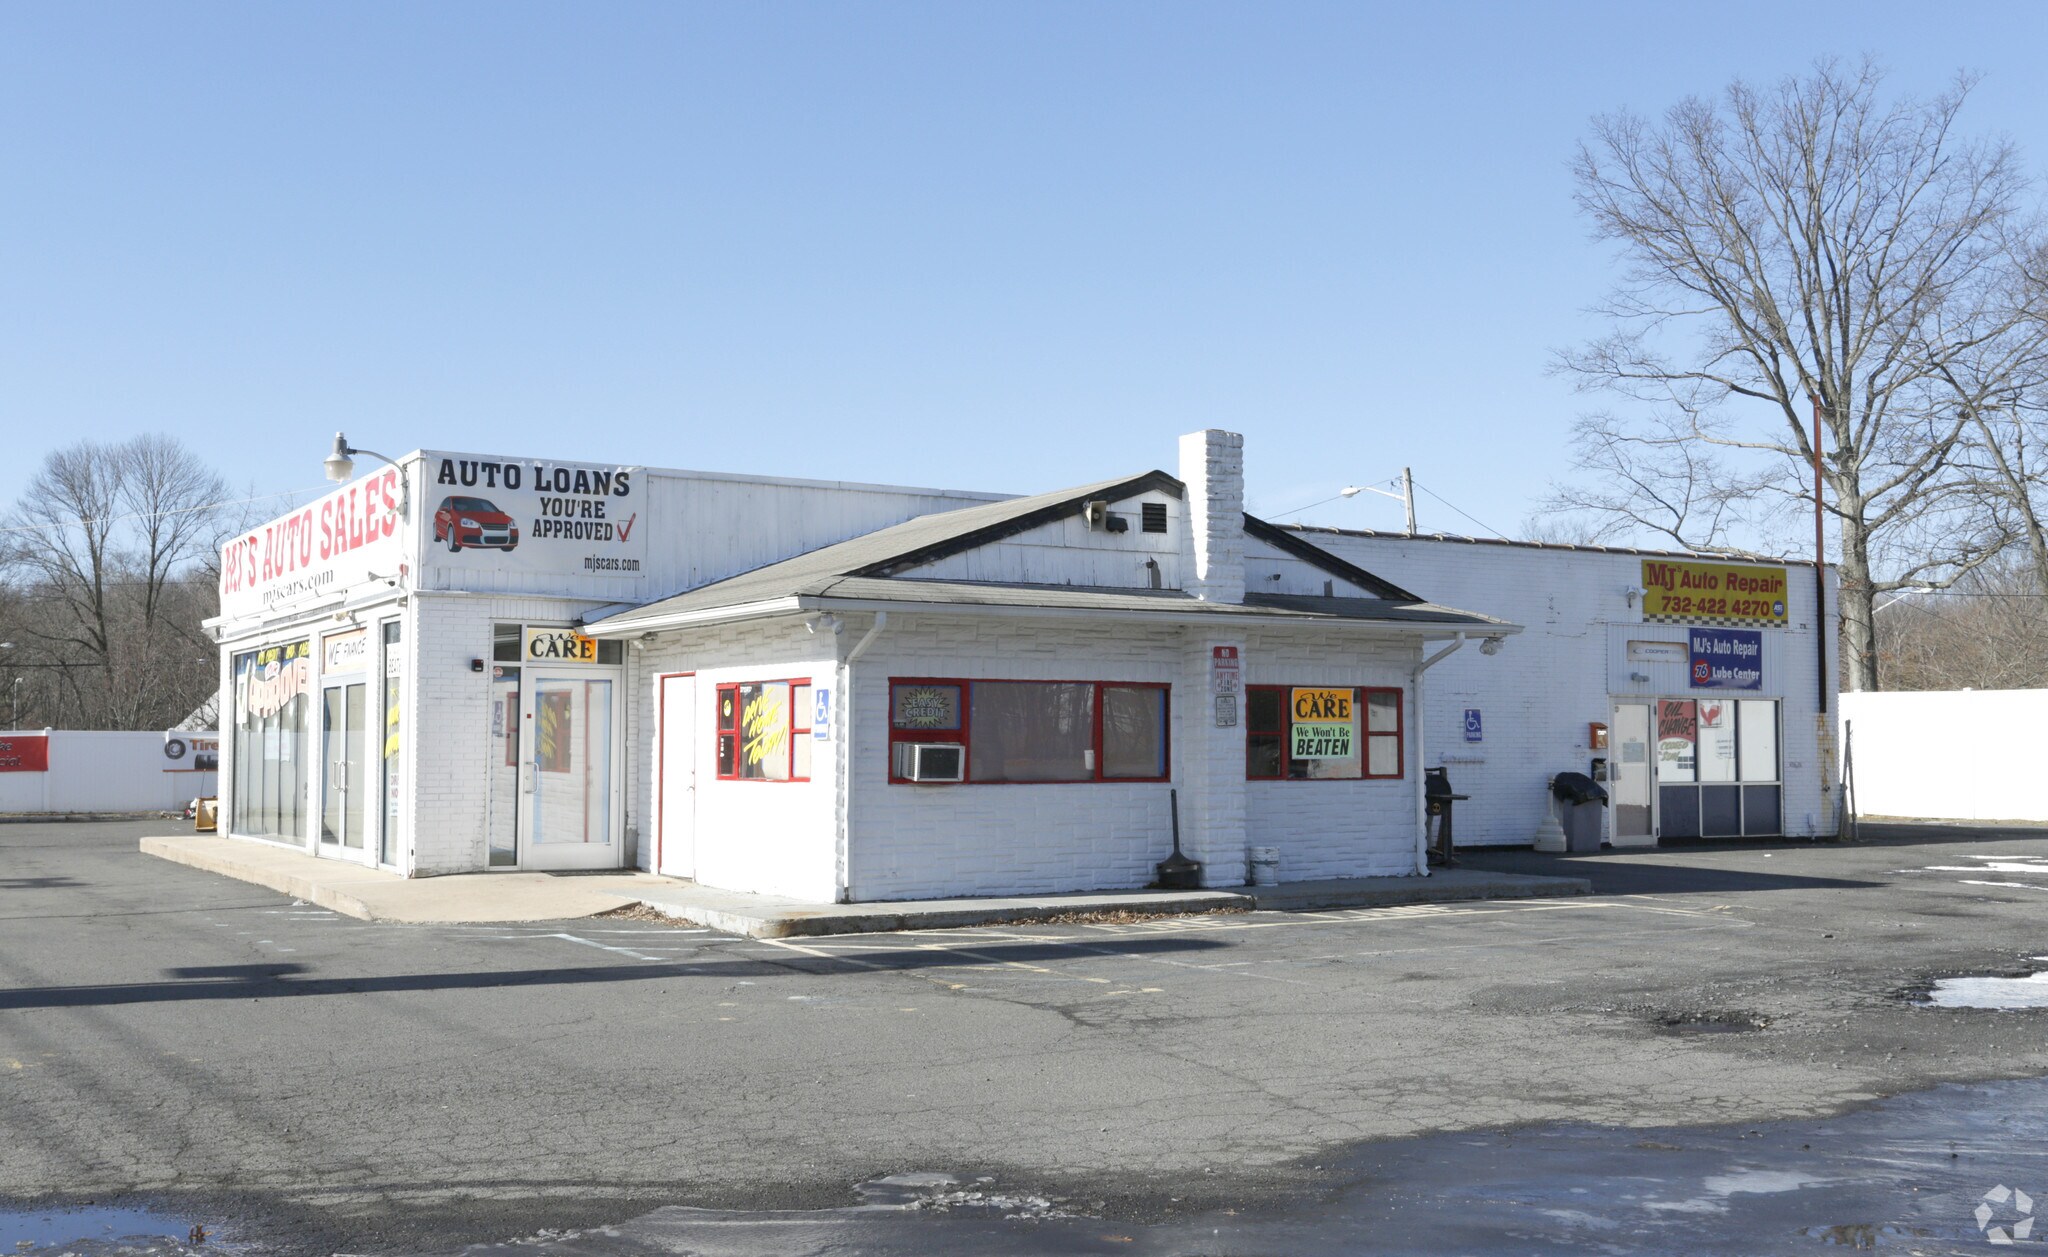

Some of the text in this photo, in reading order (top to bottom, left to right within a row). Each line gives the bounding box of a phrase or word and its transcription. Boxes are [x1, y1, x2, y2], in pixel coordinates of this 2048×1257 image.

[438, 458, 630, 497] AUTO LOANS
[540, 497, 606, 519] YOU'RE
[263, 509, 312, 581] AUTO
[320, 469, 397, 560] SALES
[532, 519, 613, 541] APPROVED
[584, 554, 640, 573] mjscars.com
[263, 569, 334, 604] mjscars.com
[1680, 569, 1719, 590] Auto
[1726, 572, 1783, 595] Repair
[1661, 596, 1770, 617] 732-422 4270
[530, 638, 593, 659] CARE
[1221, 648, 1230, 658] NO
[1693, 637, 1711, 653] MJ's
[1713, 638, 1732, 655] Auto
[1733, 641, 1758, 659] Repair
[1214, 658, 1238, 667] PARKING
[1694, 663, 1708, 678] 76
[1712, 666, 1760, 681] Lube Center
[912, 698, 939, 707] EASY
[1300, 691, 1338, 700] We
[905, 708, 945, 717] CREDIT
[1295, 698, 1349, 718] CARE
[1664, 702, 1683, 718] OIL
[1296, 727, 1350, 737] We Won't Be
[1658, 717, 1696, 738] CHANGE
[1296, 738, 1350, 756] BEATEN
